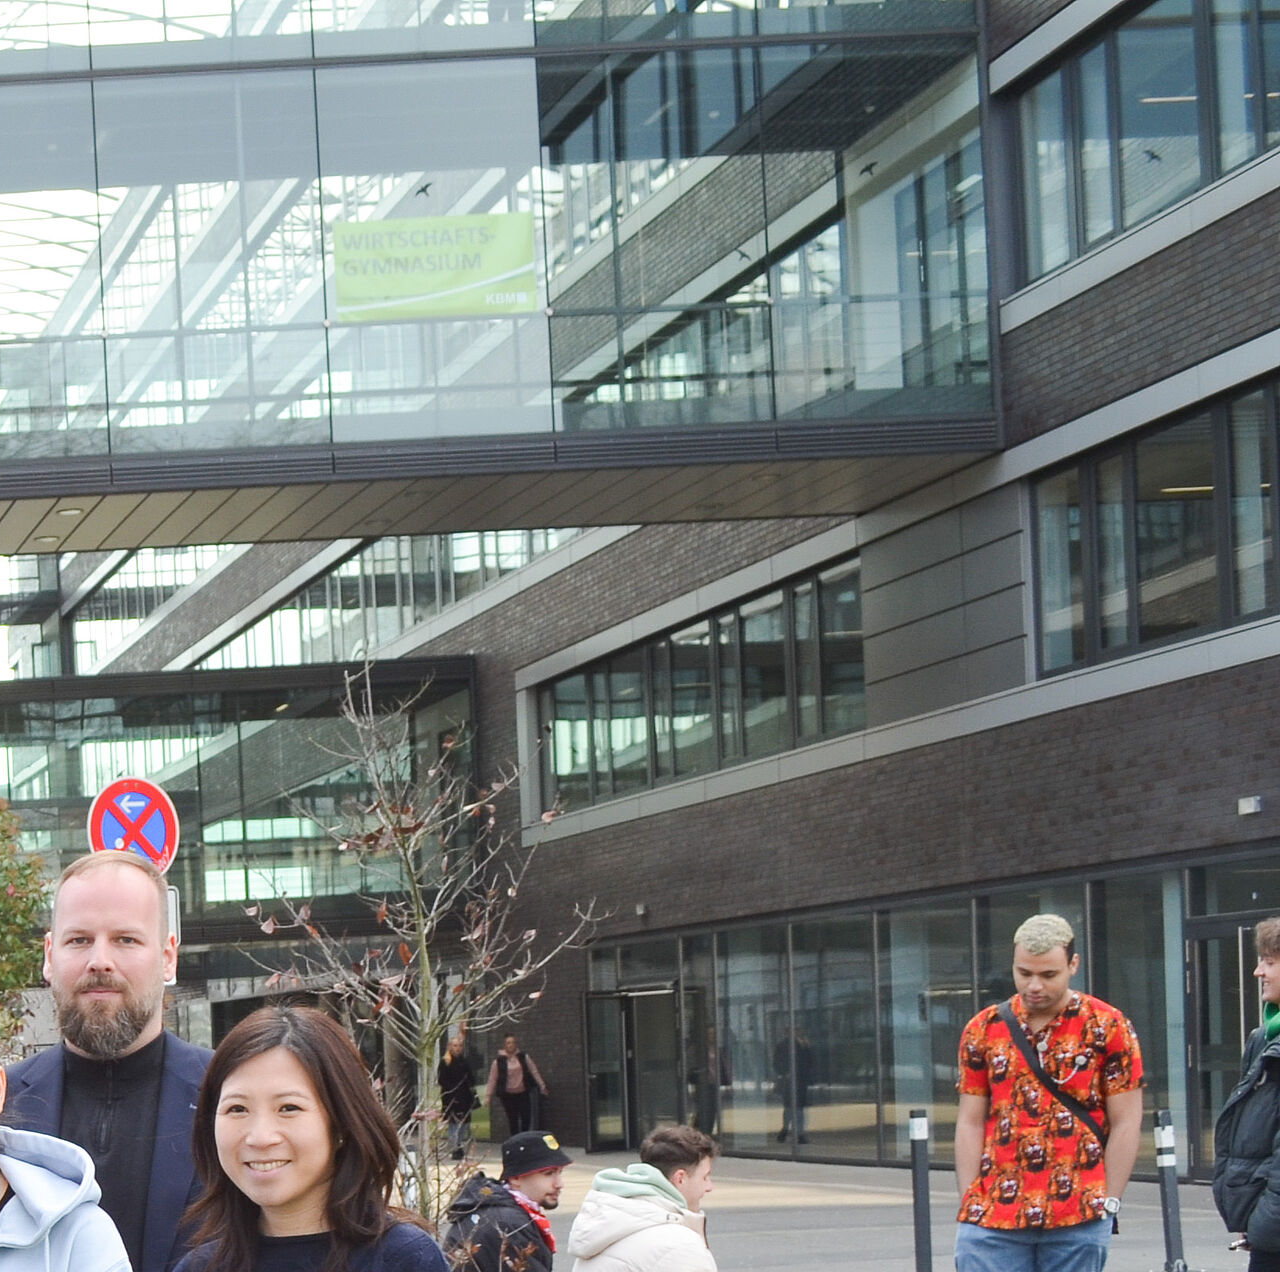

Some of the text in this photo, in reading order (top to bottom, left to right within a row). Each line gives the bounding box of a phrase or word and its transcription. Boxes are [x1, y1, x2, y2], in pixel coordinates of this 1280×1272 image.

[341, 226, 495, 250] WIRTSCHAFTS-
[343, 253, 482, 276] GYMNASIUM
[486, 293, 517, 305] KBM
